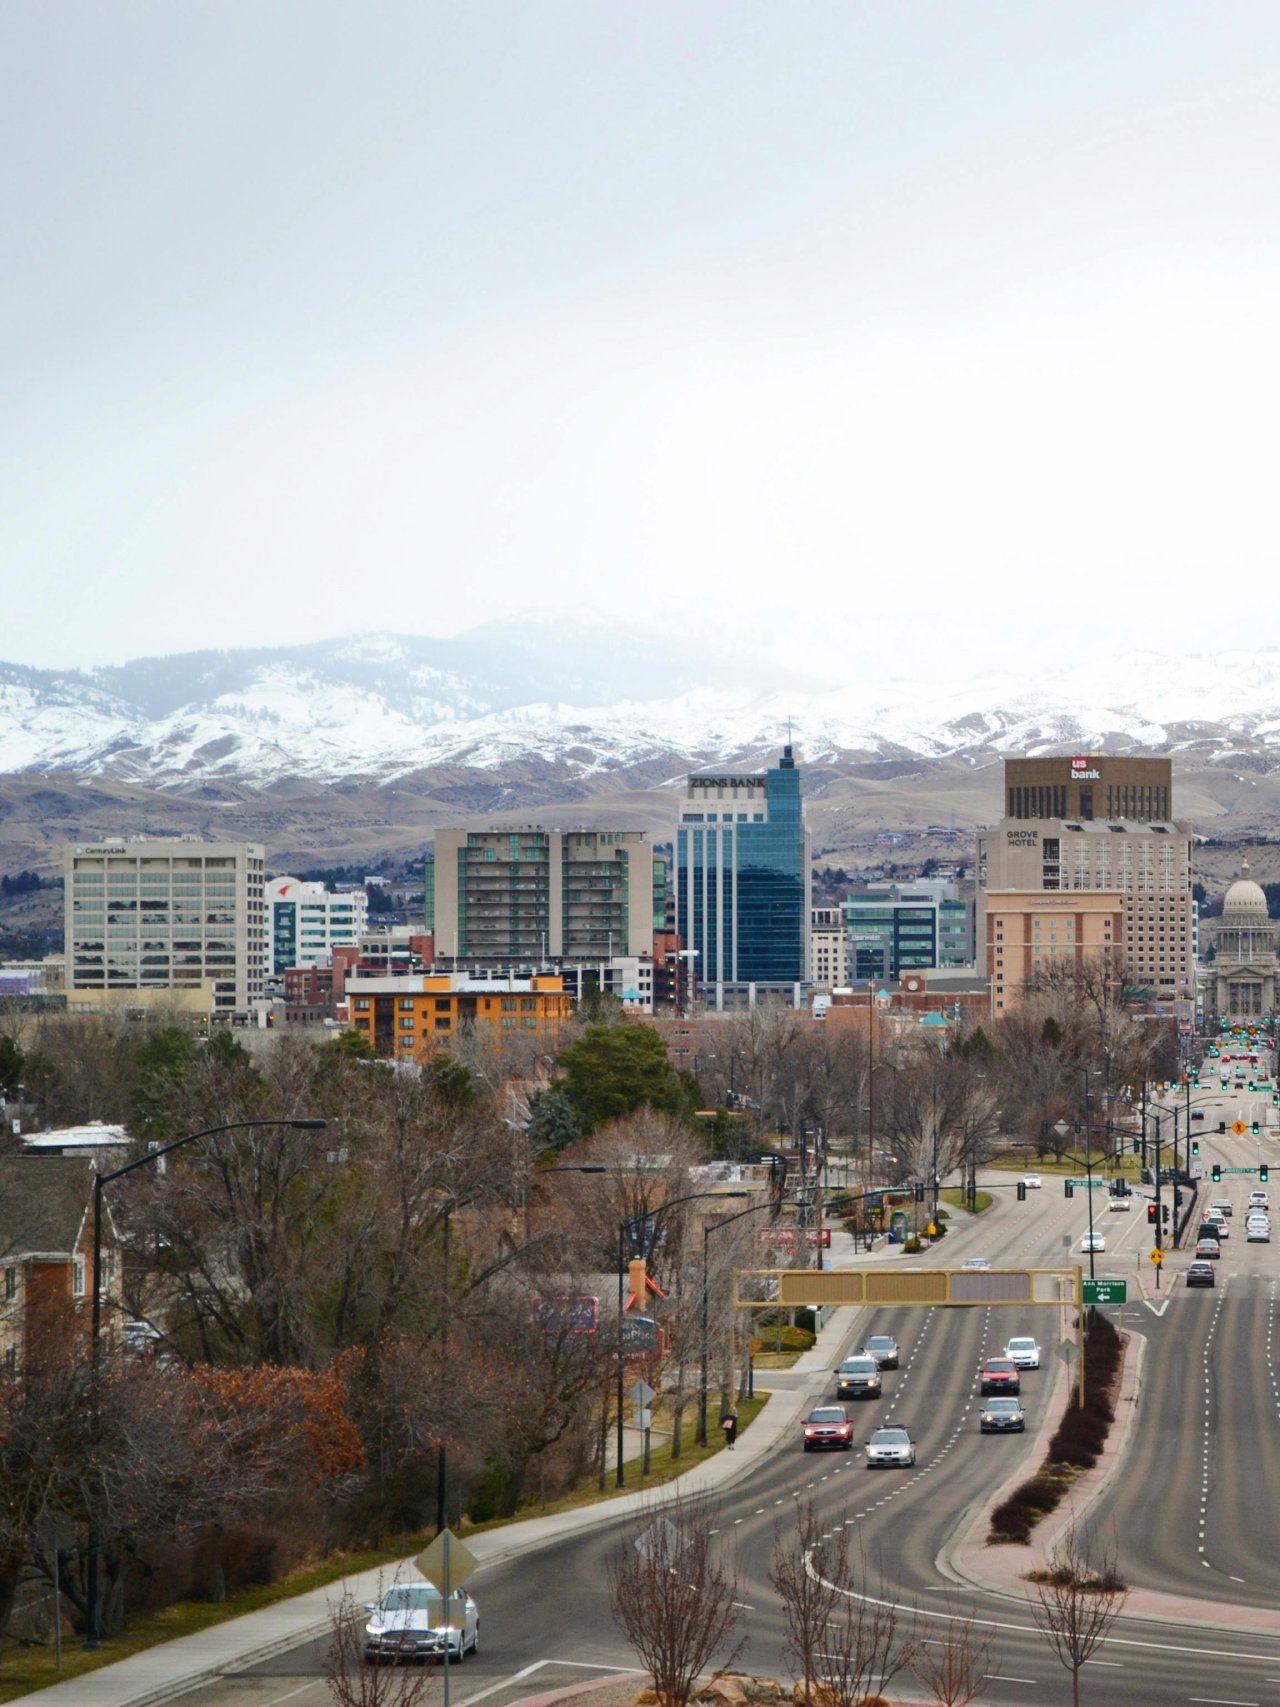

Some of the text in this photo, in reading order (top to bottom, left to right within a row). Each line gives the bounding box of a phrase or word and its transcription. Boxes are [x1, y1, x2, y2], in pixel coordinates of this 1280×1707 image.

[1072, 760, 1086, 768] us
[1071, 769, 1100, 779] bank
[691, 778, 766, 788] ZIONS BANK
